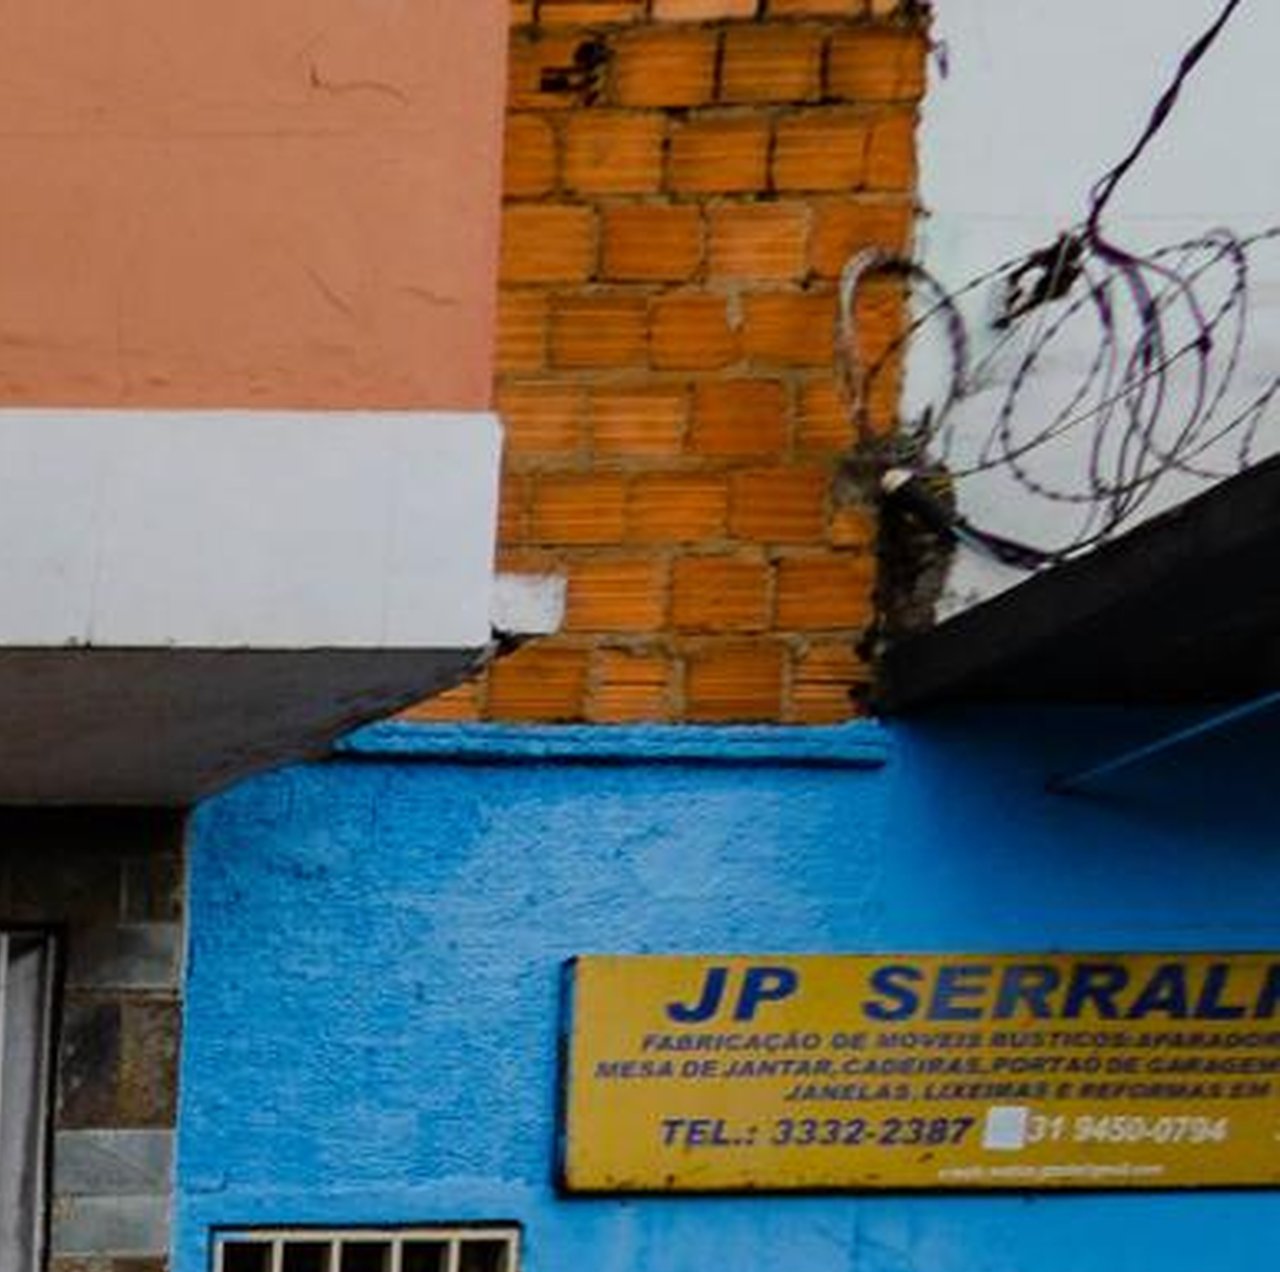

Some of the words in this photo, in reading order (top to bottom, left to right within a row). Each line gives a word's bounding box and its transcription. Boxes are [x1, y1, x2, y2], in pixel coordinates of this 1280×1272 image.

[665, 965, 799, 1023] JP
[661, 1118, 758, 1147] TEL.:
[770, 1116, 976, 1146] 3332-2387
